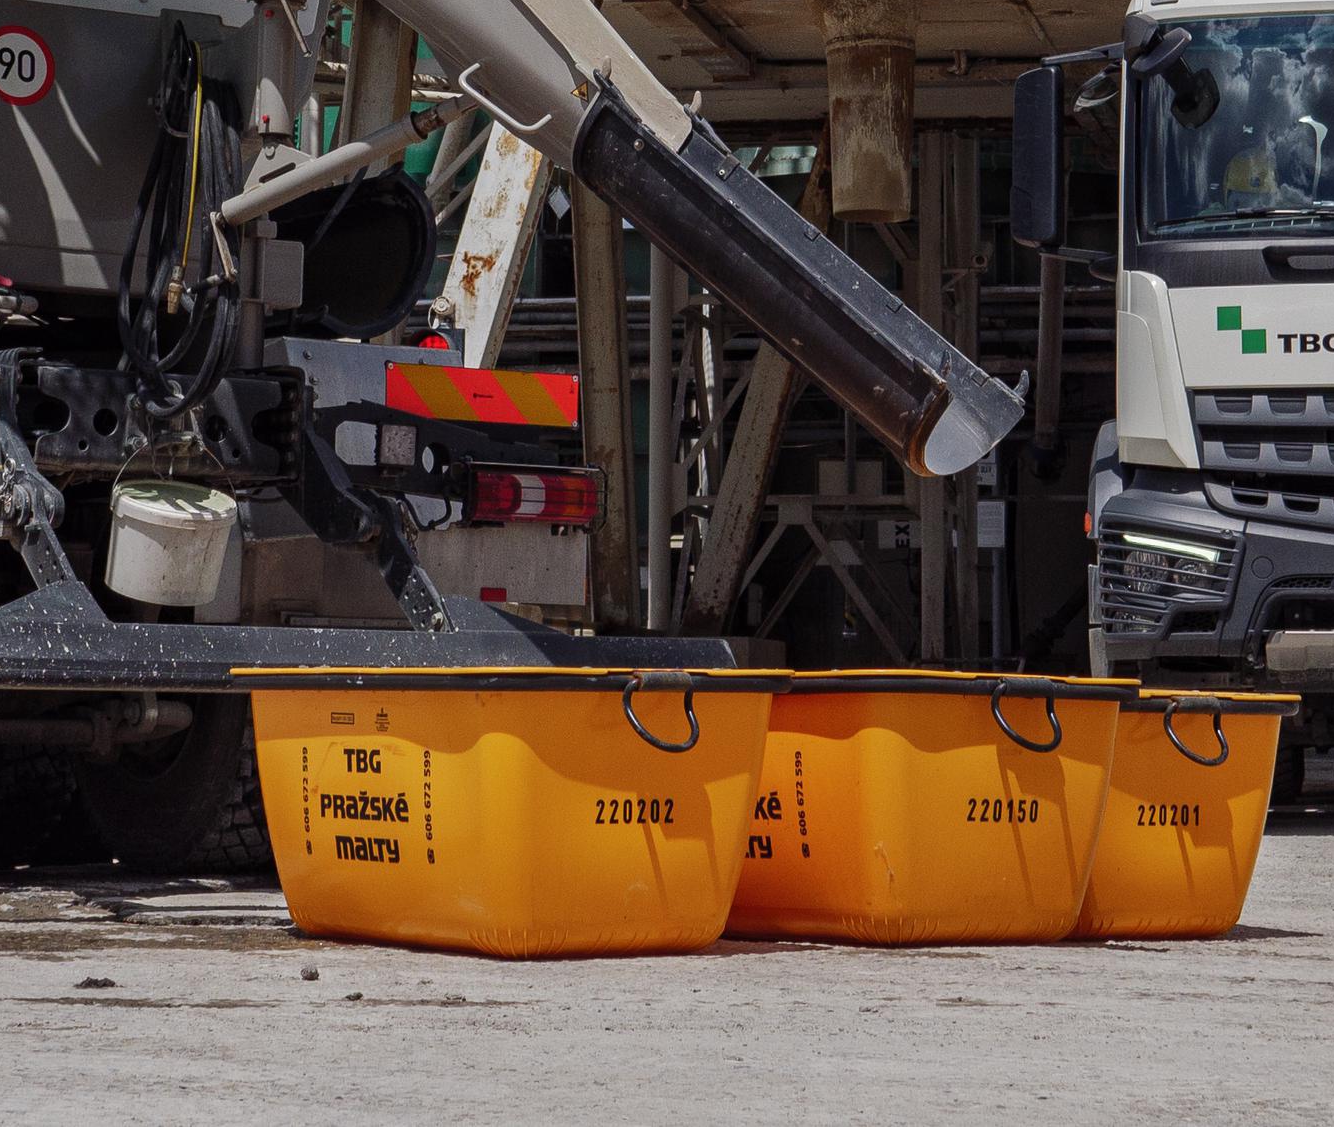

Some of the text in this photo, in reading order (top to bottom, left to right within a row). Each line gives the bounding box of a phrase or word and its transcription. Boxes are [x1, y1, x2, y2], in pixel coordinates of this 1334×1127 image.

[343, 748, 382, 774] TBG
[423, 750, 433, 841] 606 672 599
[794, 750, 808, 836] 606 672 599
[595, 798, 675, 824] 220202
[966, 798, 1040, 823] 220150
[1137, 804, 1201, 827] 220201
